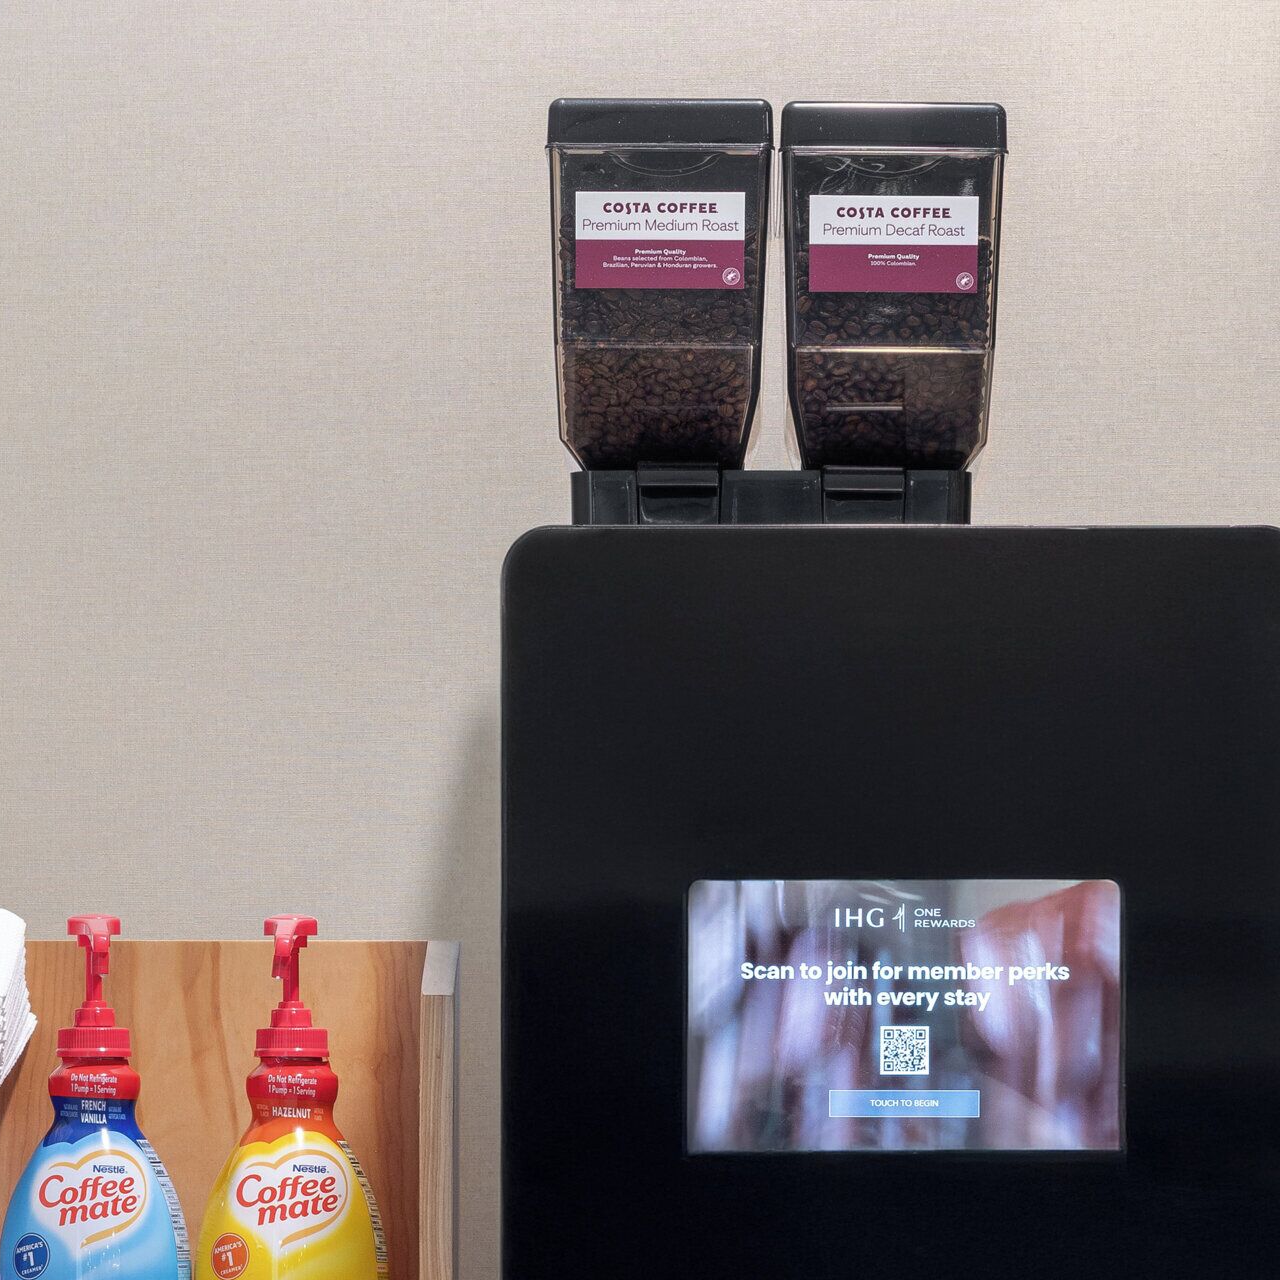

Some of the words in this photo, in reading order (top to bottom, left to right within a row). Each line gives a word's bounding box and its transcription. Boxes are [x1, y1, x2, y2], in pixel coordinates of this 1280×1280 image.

[603, 202, 651, 214] COSTA
[657, 202, 718, 213] COFFEE
[836, 207, 884, 219] COSTA
[890, 207, 951, 218] COFFEE
[582, 219, 641, 231] Premium
[645, 219, 698, 231] Medium
[702, 219, 739, 231] Roast
[823, 223, 881, 236] Premium
[886, 224, 925, 236] Decaf
[928, 224, 965, 237] Roast
[834, 908, 884, 928] IHG
[914, 908, 941, 917] ONE
[914, 919, 976, 928] REWARDS
[740, 962, 795, 980] Scan
[799, 964, 822, 980] to
[824, 961, 868, 985] join
[872, 962, 902, 980] for
[907, 961, 1004, 980] member
[1008, 961, 1070, 985] perks
[824, 988, 871, 1006] with
[876, 993, 938, 1011] every
[944, 990, 990, 1011] stay
[71, 1073, 78, 1081] Do
[79, 1074, 88, 1082] Not
[89, 1073, 117, 1085] Refrigerate
[268, 1074, 275, 1082] Do
[276, 1075, 287, 1083] Not
[287, 1074, 317, 1086] Refrigerate
[74, 1084, 89, 1094] Pump
[97, 1085, 116, 1096] Serving
[272, 1085, 287, 1096] Pump
[296, 1086, 316, 1097] Serving
[81, 1100, 106, 1111] FRENCH
[81, 1112, 107, 1124] VANILLA
[272, 1106, 311, 1119] HAZELNUT
[38, 1174, 135, 1208] Coffee
[236, 1174, 336, 1208] Coffee
[59, 1195, 137, 1226] mate
[258, 1194, 339, 1226] mate
[15, 1241, 44, 1255] AMERICA'S
[213, 1241, 243, 1255] AMERICA'S
[22, 1251, 35, 1266] #1
[221, 1251, 234, 1266] #1
